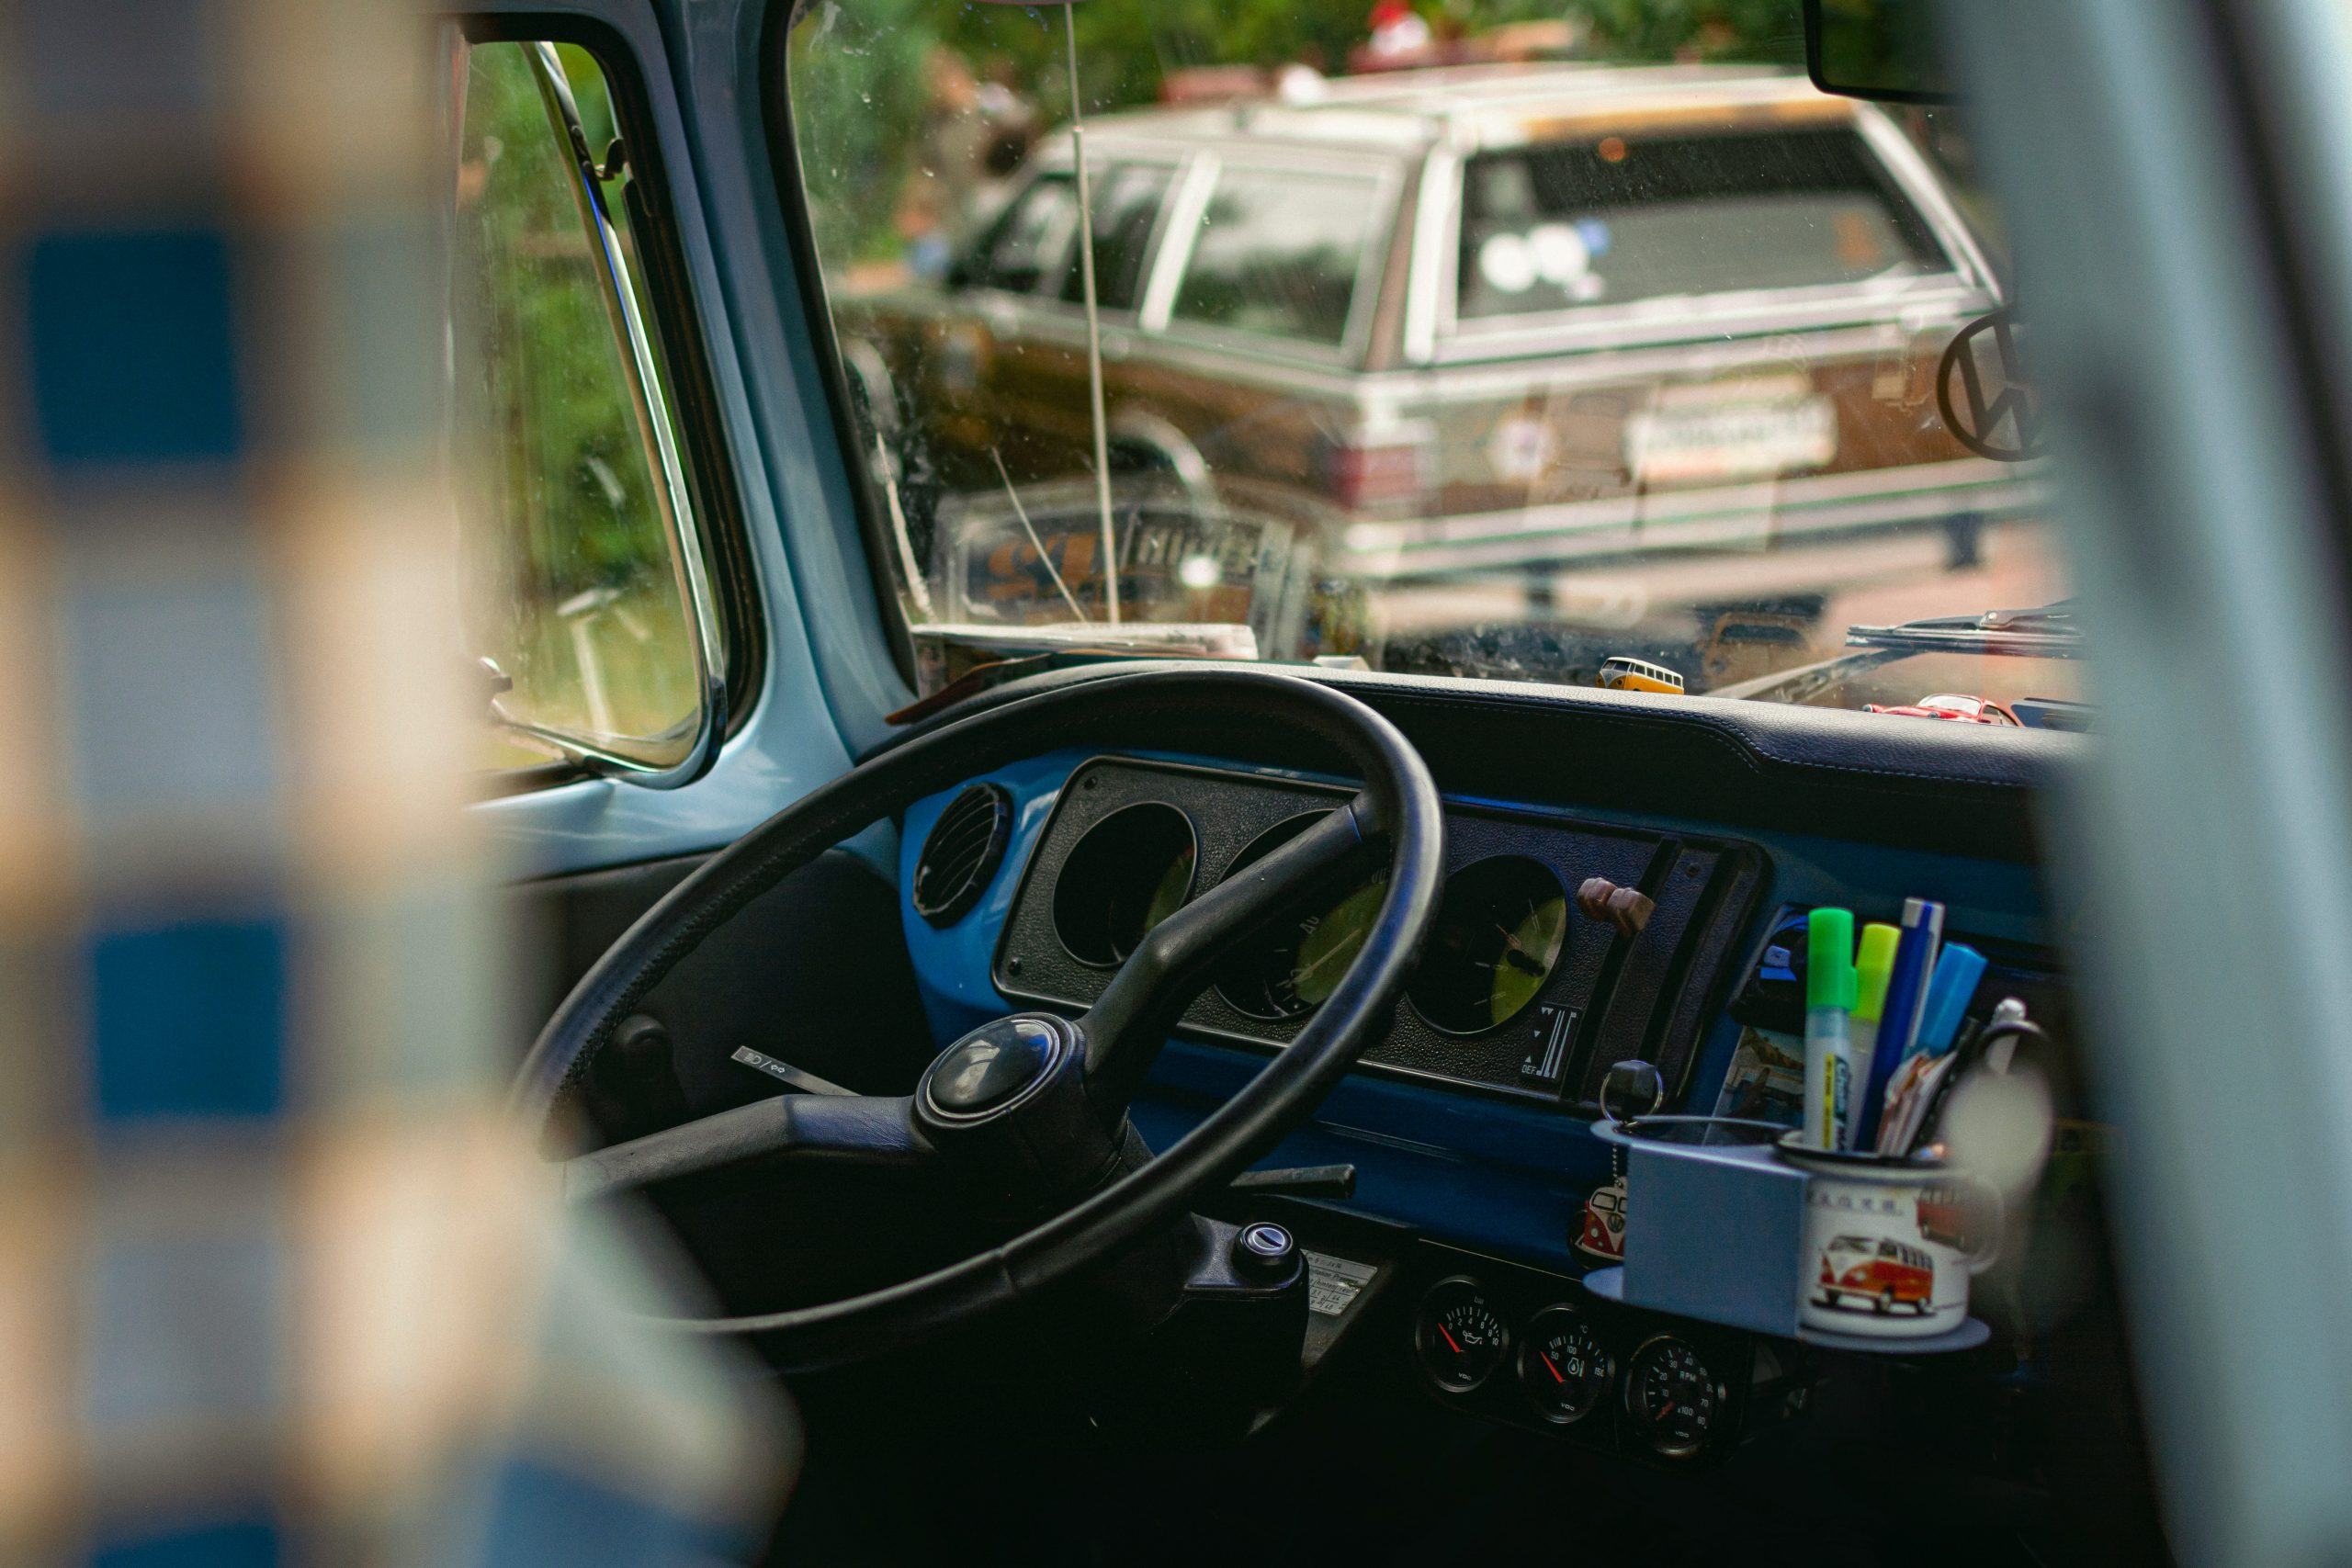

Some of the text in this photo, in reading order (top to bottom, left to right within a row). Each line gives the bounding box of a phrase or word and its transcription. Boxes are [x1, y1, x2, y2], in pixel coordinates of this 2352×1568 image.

[1458, 1318, 1463, 1326] 2
[1480, 1321, 1485, 1329] 6
[1487, 1329, 1492, 1337] 8
[1493, 1337, 1498, 1346] 10
[1551, 1351, 1559, 1359] 50
[1567, 1345, 1577, 1354] 100
[1668, 1360, 1677, 1369] 30
[1684, 1358, 1693, 1366] 40
[1659, 1372, 1668, 1381] 20
[1679, 1371, 1696, 1382] RPM
[1661, 1389, 1669, 1397] 10
[1701, 1398, 1709, 1407] 70
